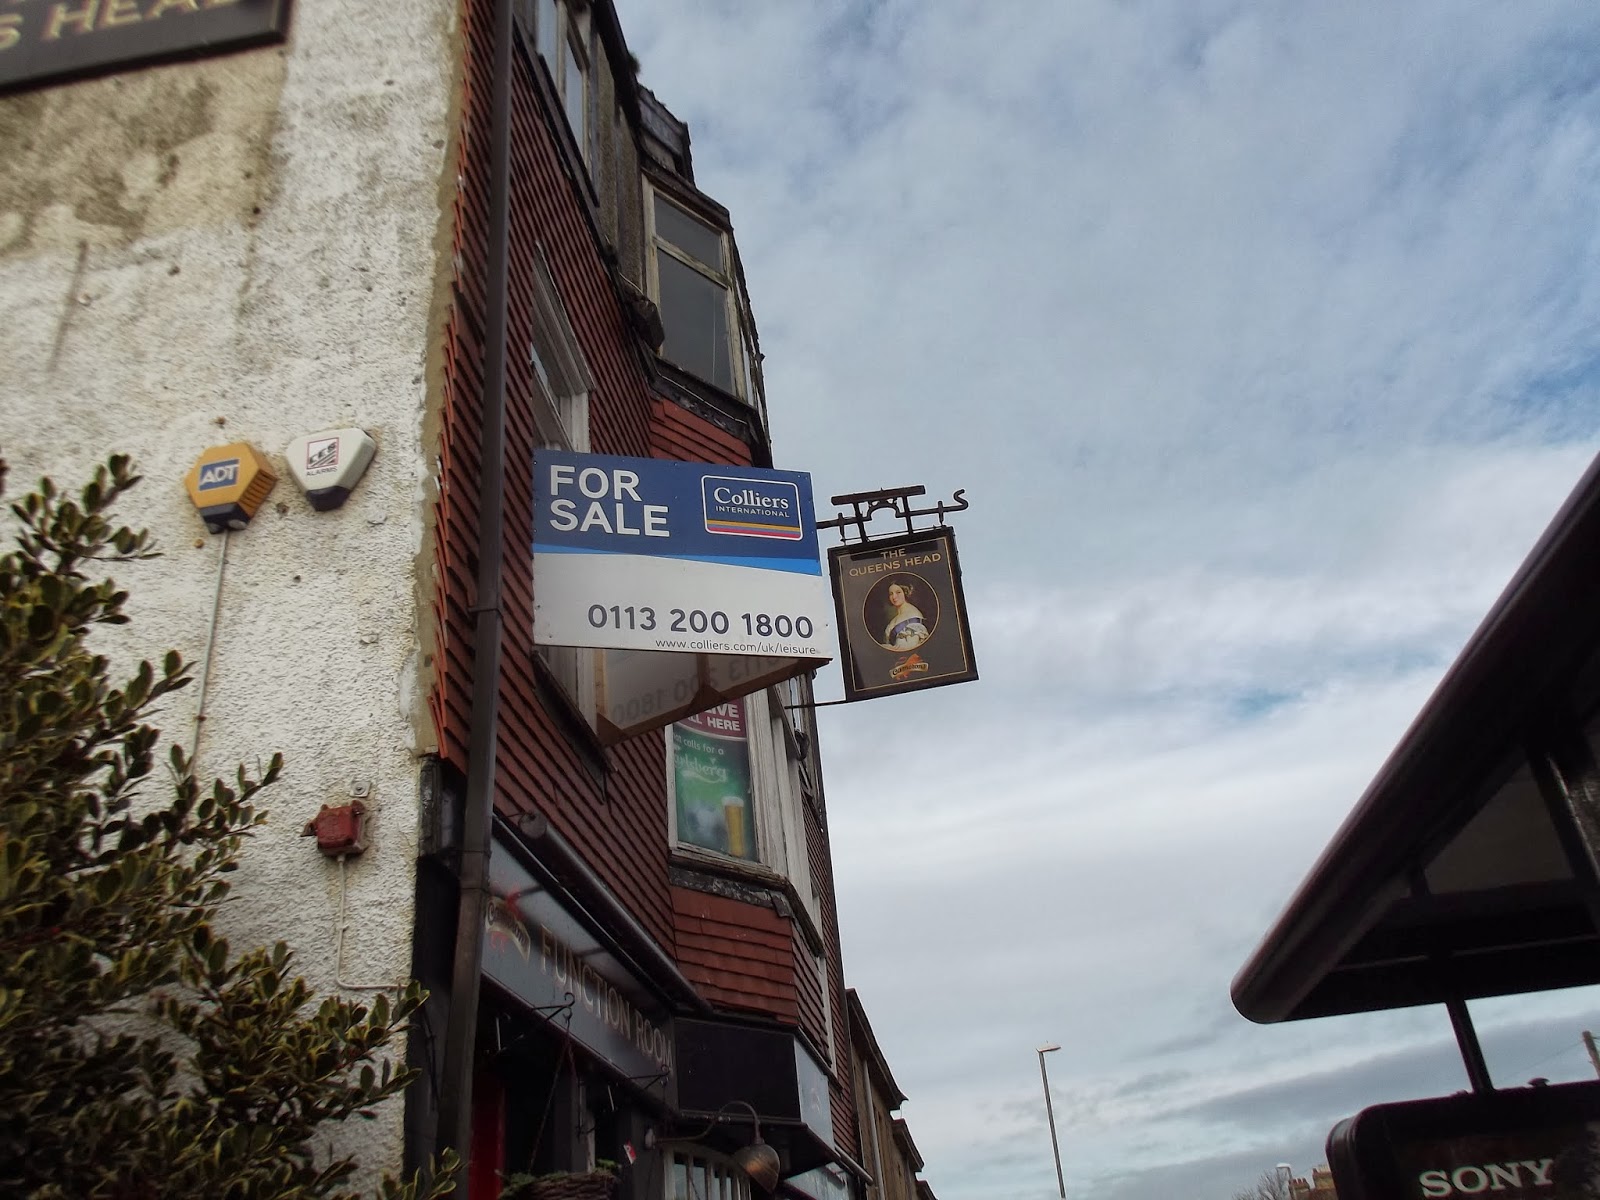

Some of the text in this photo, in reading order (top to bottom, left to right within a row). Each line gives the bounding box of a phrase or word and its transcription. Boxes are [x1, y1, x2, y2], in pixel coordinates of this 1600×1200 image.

[200, 463, 240, 486] ADT
[306, 466, 338, 477] ALARMS
[550, 464, 642, 502] FOR
[713, 486, 789, 510] Colliers
[550, 499, 670, 538] SALE
[715, 505, 790, 518] INTERNATIONAL
[849, 553, 941, 577] QUEENS HEAD
[881, 548, 907, 560] THE
[587, 604, 814, 639] 0113 200 1800
[655, 638, 816, 656] www.colliers.com/uk/leisure
[707, 716, 741, 731] HERE
[683, 738, 701, 751] calls
[703, 742, 715, 753] for
[717, 748, 725, 756] a
[540, 922, 632, 1041] FUNCTION
[635, 1009, 674, 1077] ROOM
[1418, 1158, 1554, 1199] SONY
